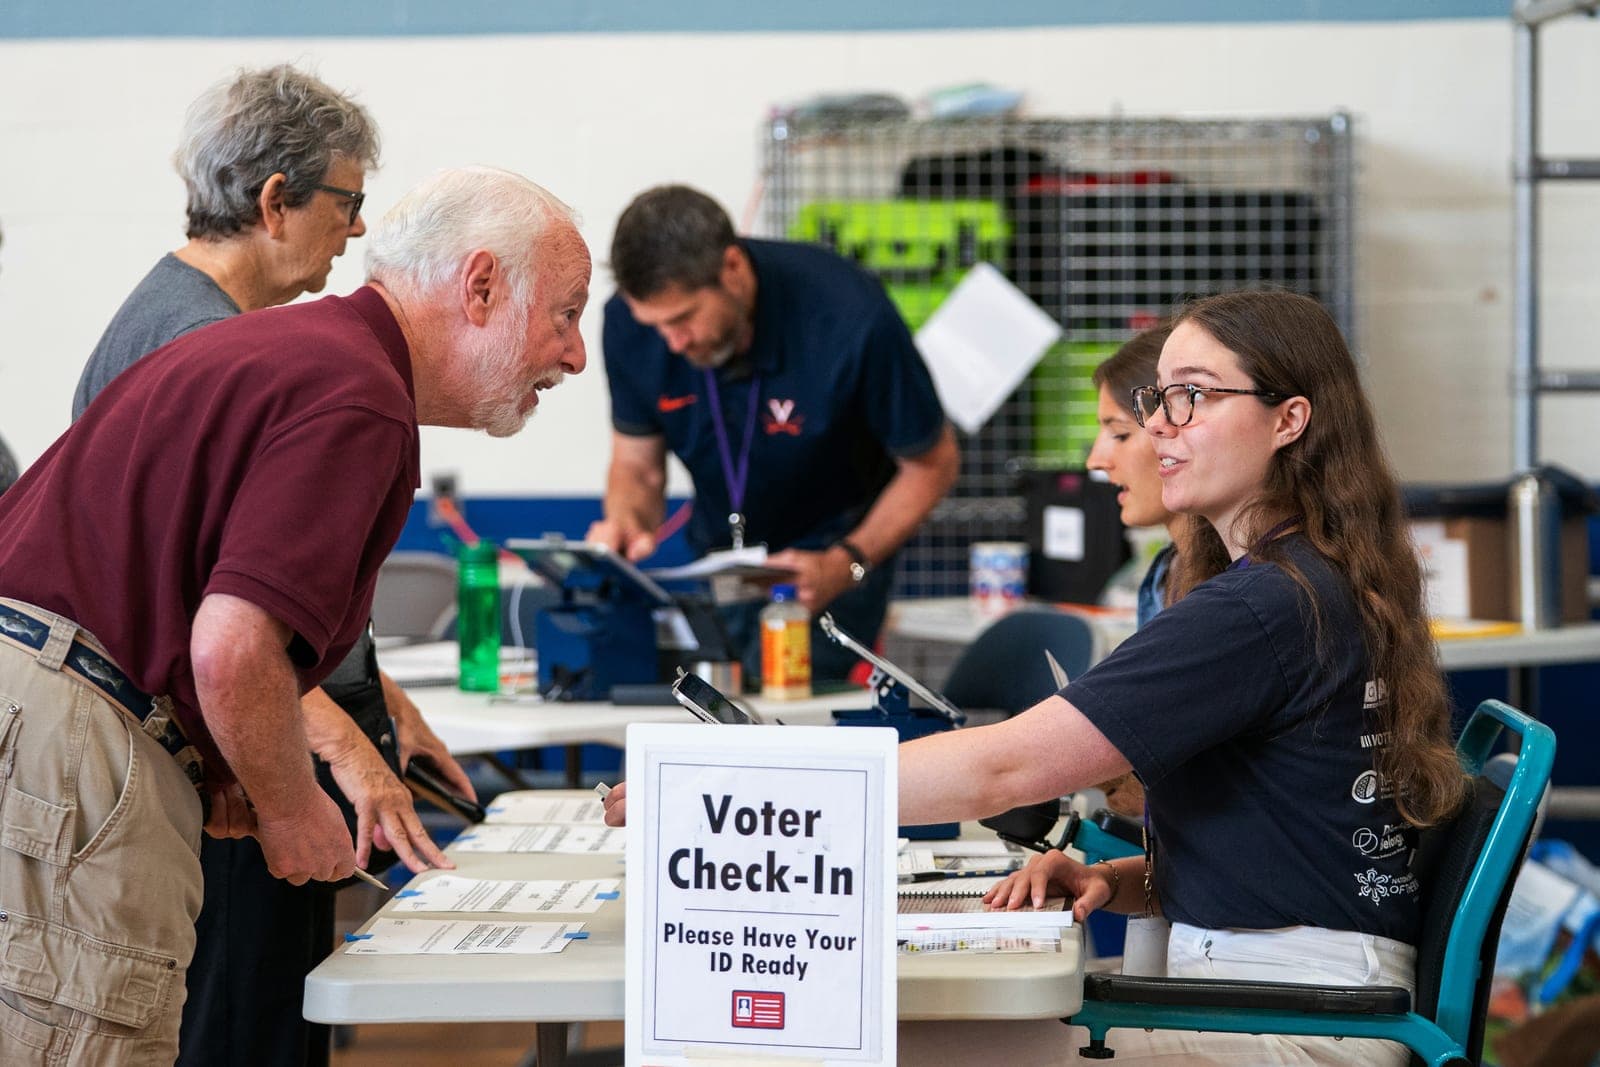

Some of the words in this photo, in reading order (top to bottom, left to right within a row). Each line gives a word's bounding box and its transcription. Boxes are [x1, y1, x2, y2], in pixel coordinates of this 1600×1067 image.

[702, 793, 822, 838] Voter
[668, 847, 853, 896] Check-In
[664, 922, 734, 946] Please
[743, 926, 797, 948] Have
[805, 929, 857, 951] Your
[710, 951, 733, 972] ID
[742, 953, 809, 981] Ready
